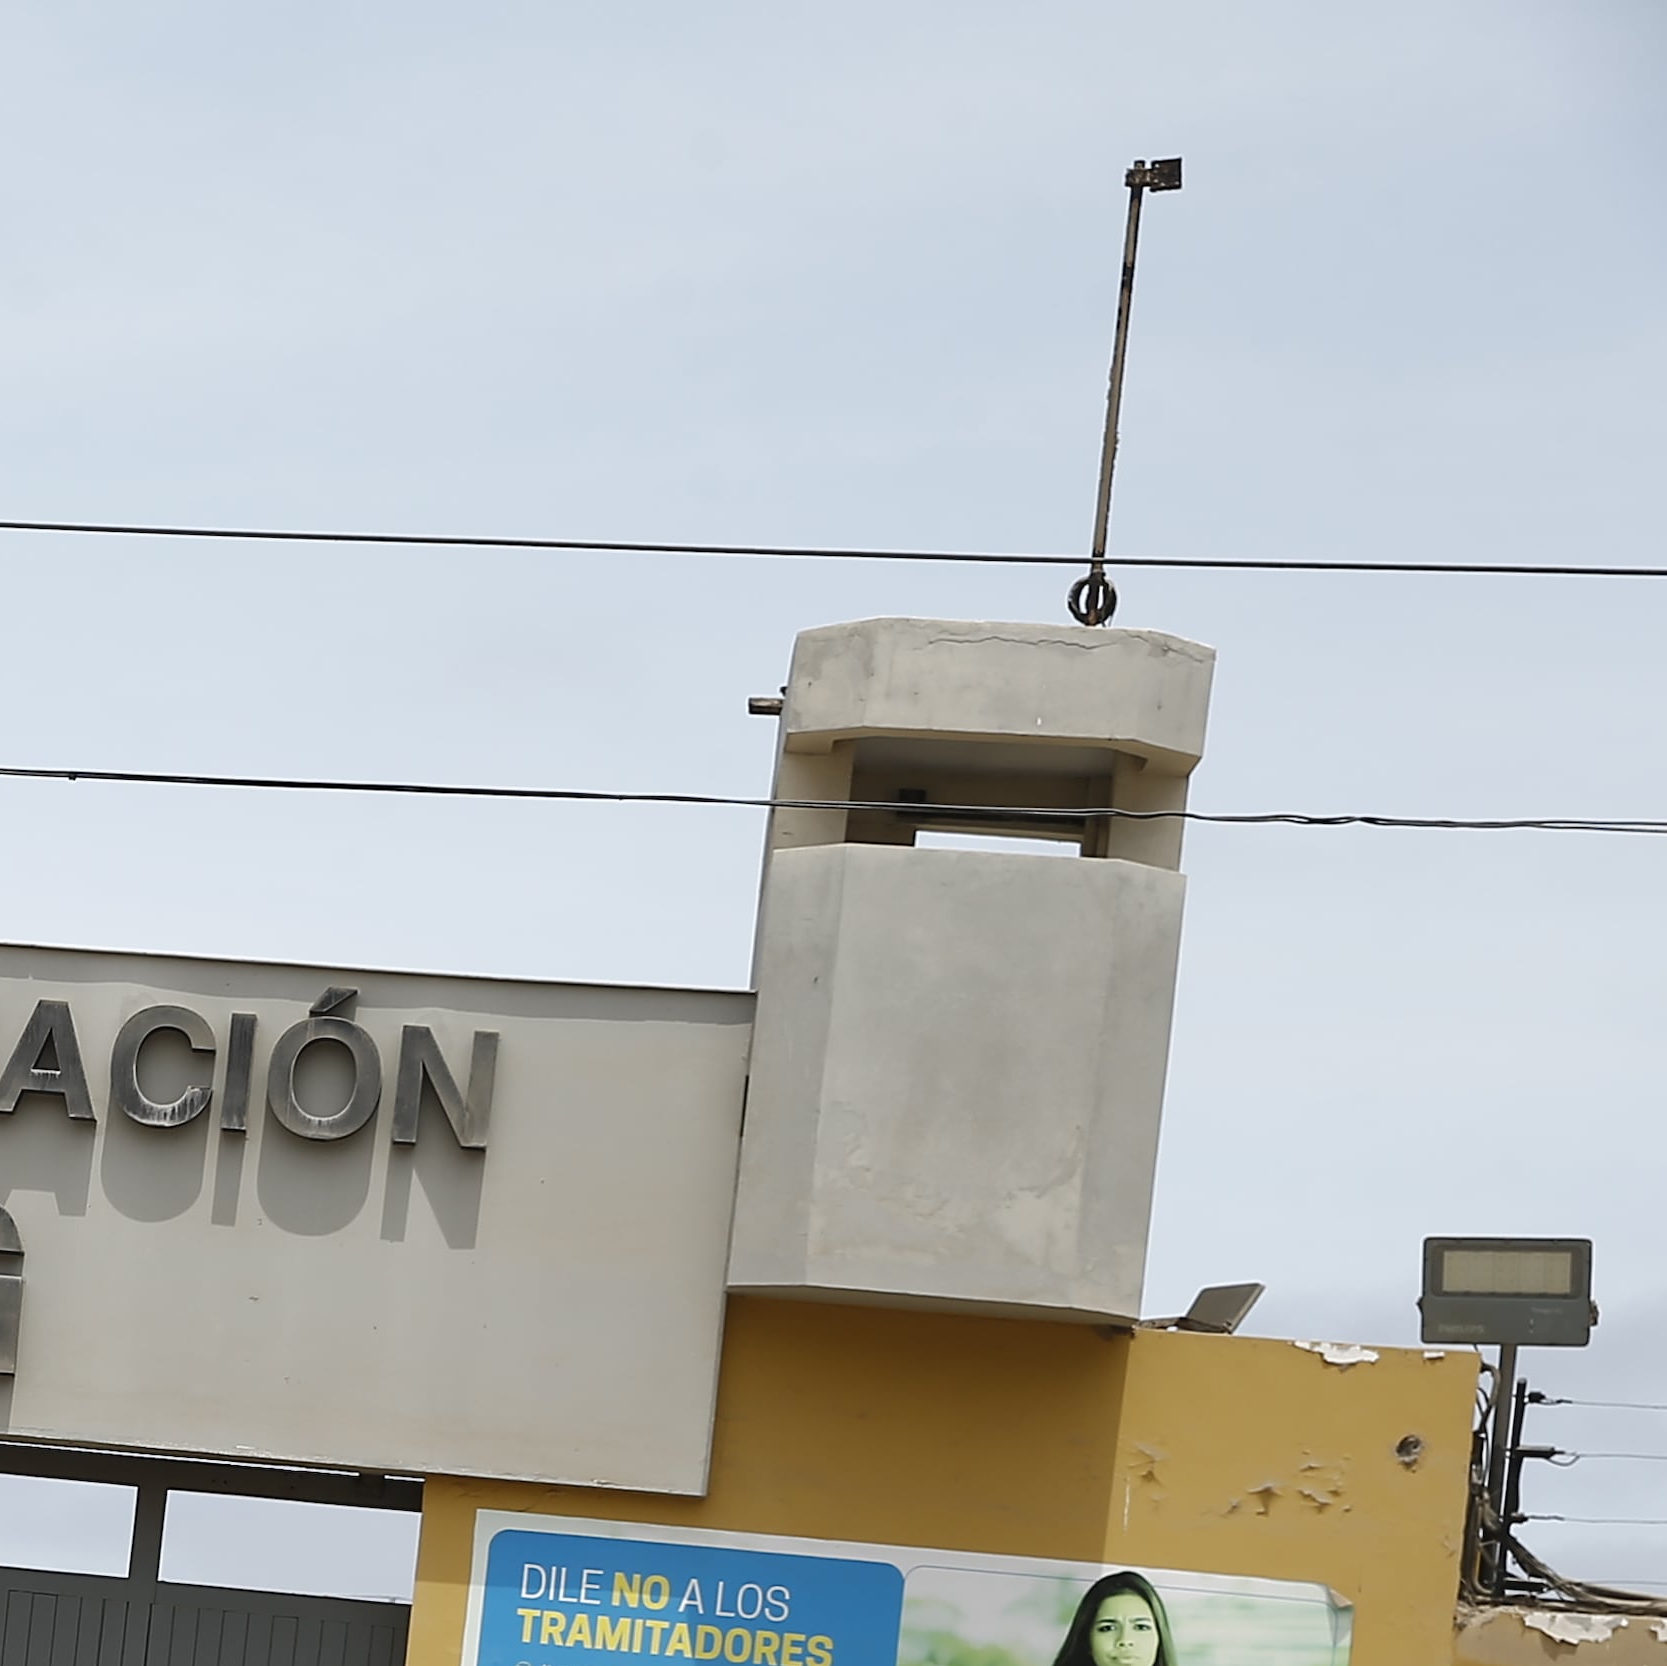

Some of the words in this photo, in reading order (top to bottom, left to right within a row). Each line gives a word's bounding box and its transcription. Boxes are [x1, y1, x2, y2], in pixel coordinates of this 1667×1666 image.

[520, 1563, 604, 1605] DILE
[611, 1571, 670, 1610] NO
[677, 1578, 704, 1614] A
[714, 1580, 790, 1622] LOS
